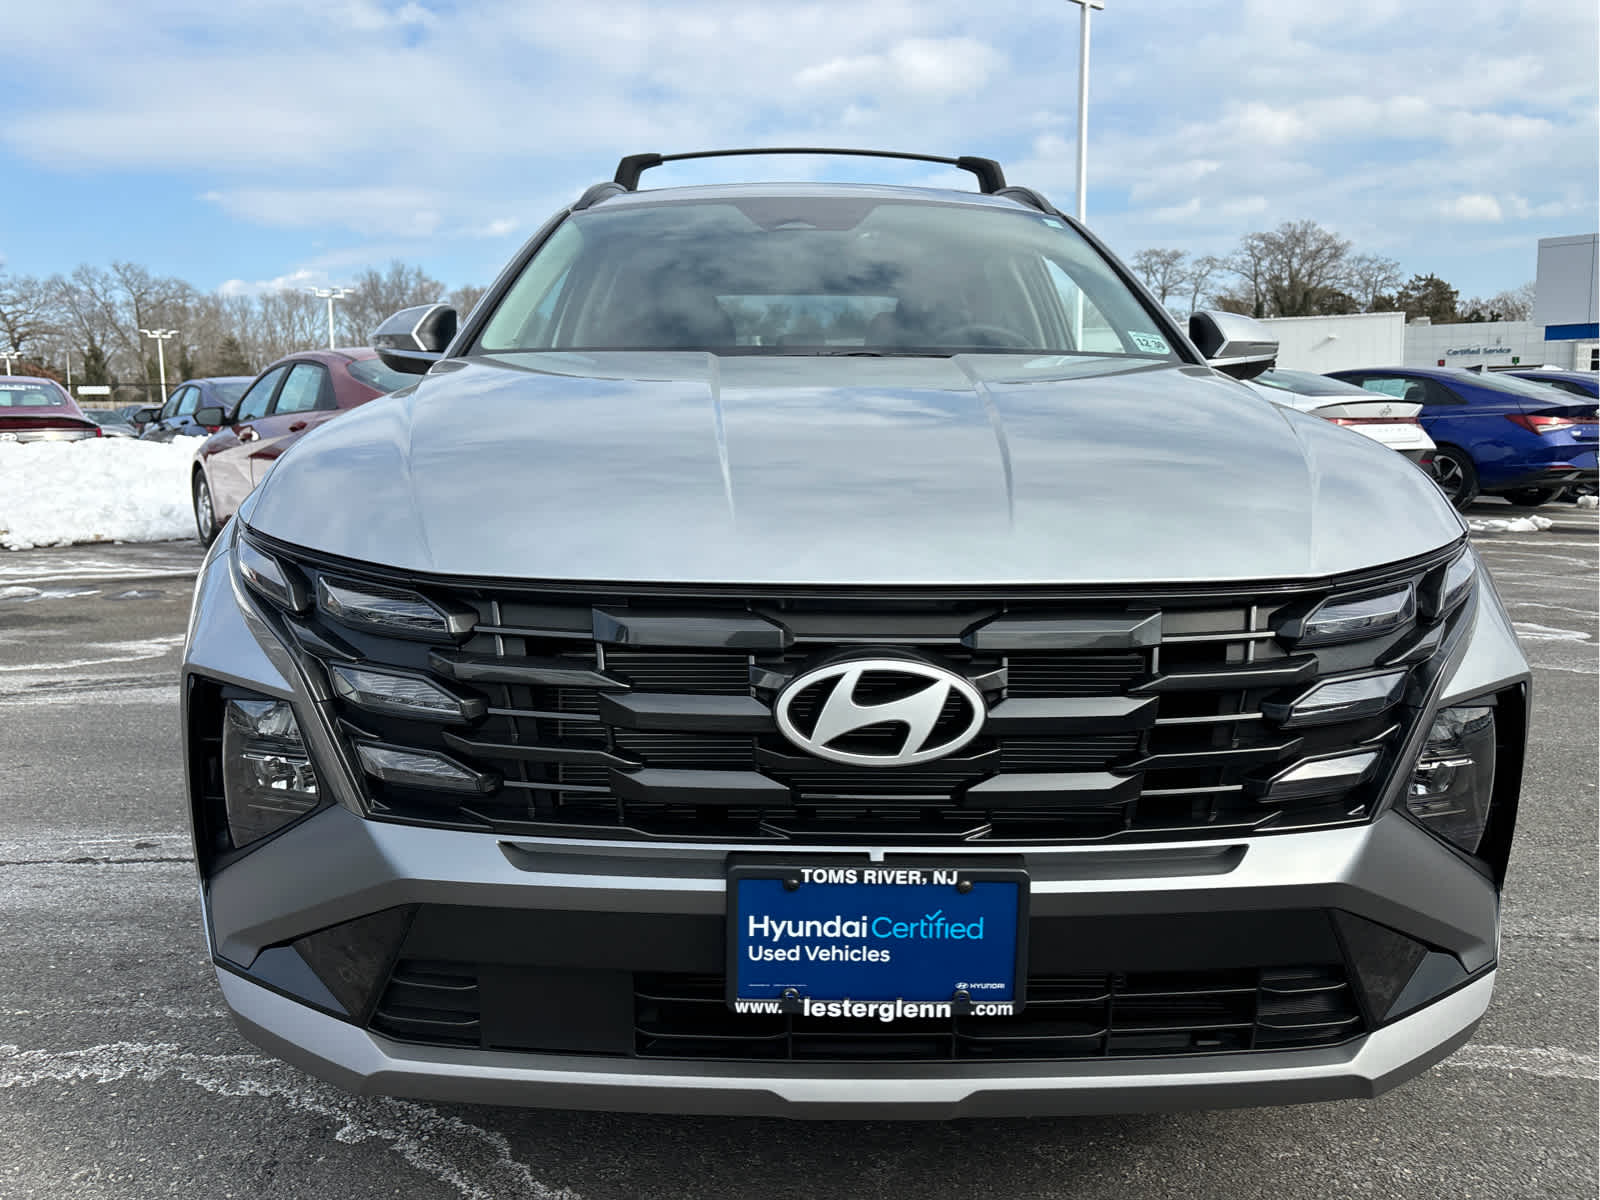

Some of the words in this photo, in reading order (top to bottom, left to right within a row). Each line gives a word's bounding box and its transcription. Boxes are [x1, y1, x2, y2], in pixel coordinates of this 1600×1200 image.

[801, 868, 857, 884] TOMS
[863, 869, 928, 885] RIVER,
[932, 870, 959, 885] NJ
[748, 915, 868, 942] Hyundai
[871, 909, 984, 940] Certified
[748, 945, 800, 962] Used
[804, 945, 891, 963] Vehicles
[969, 982, 1005, 990] HYUNDAI
[734, 1002, 783, 1015] www.
[803, 998, 952, 1023] lesterglenn
[970, 1002, 1014, 1016] .com
